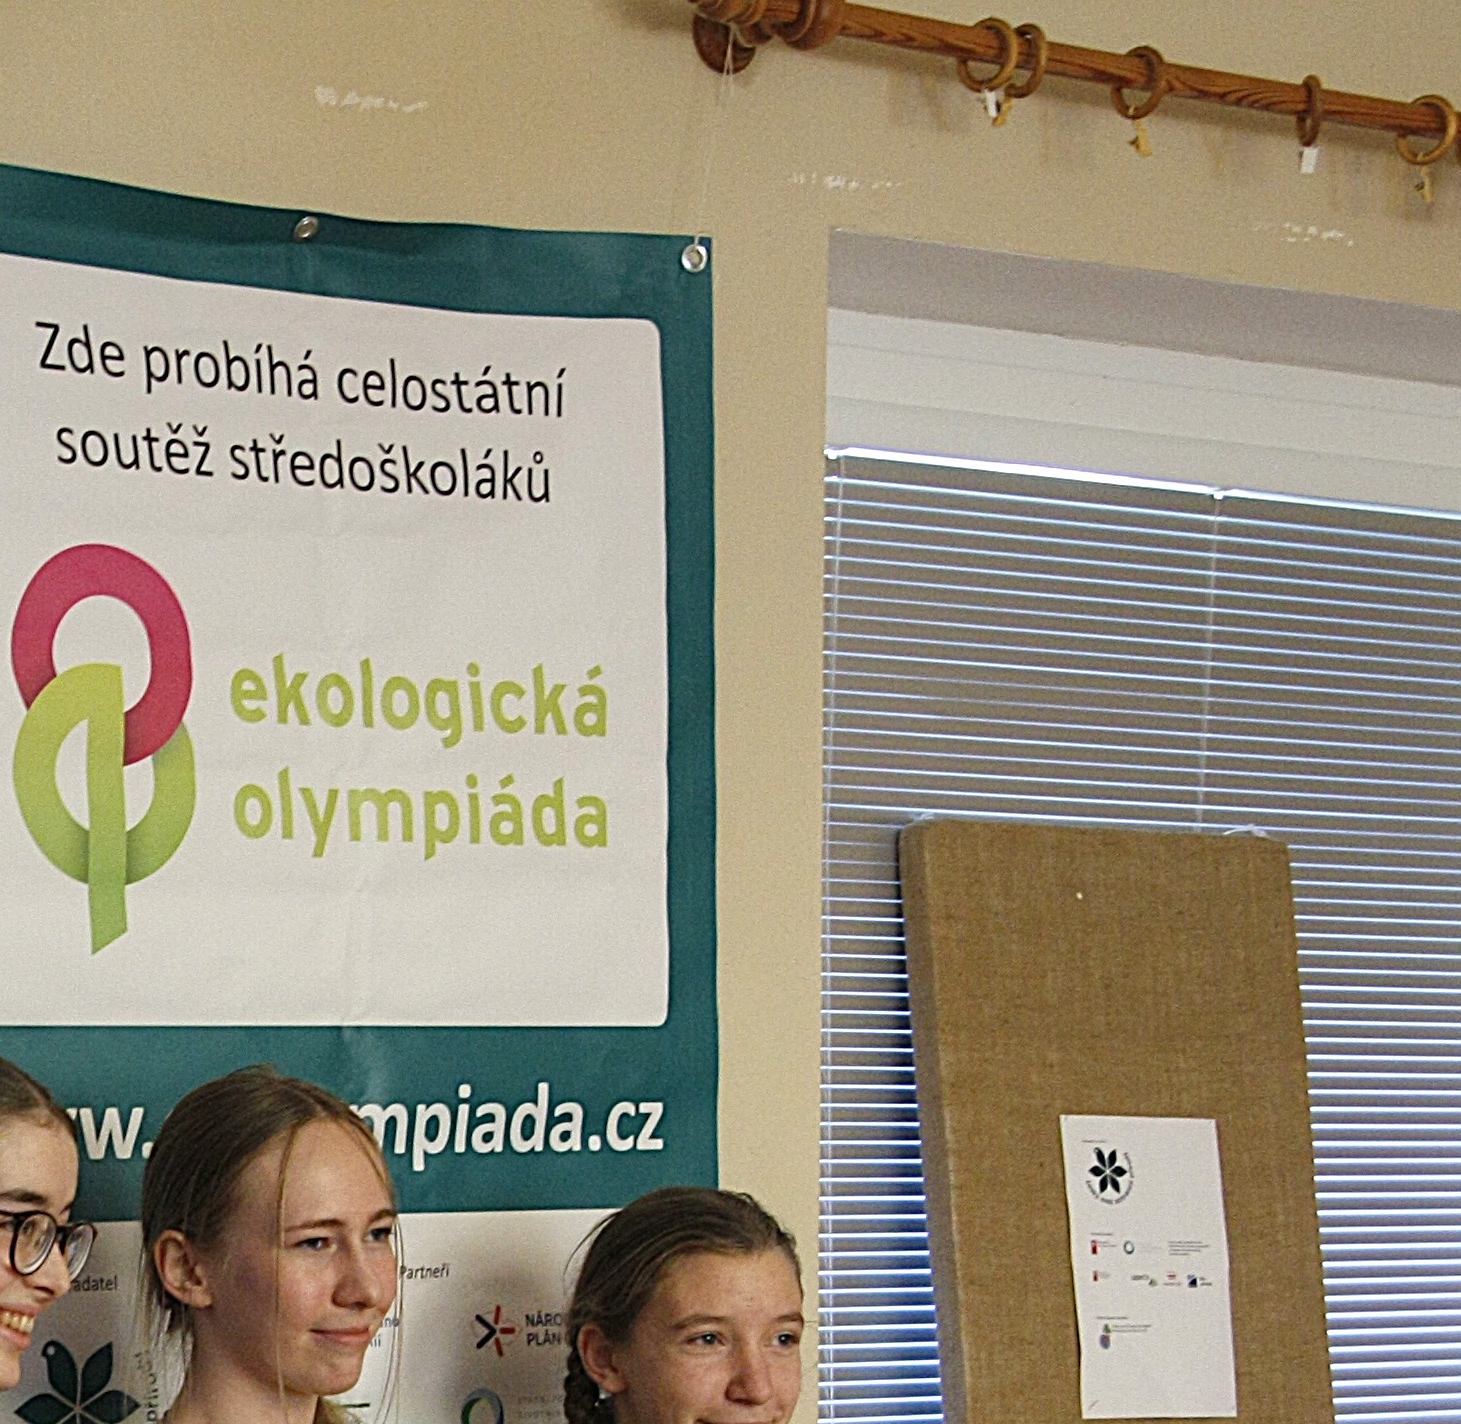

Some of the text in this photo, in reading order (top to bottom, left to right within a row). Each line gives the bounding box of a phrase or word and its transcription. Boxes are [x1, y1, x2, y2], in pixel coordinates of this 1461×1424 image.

[34, 321, 566, 418] Zde probíhá celostátní
[55, 424, 552, 504] soutěž středoškoláků
[230, 654, 608, 749] ekologická
[234, 767, 610, 860] olympiáda
